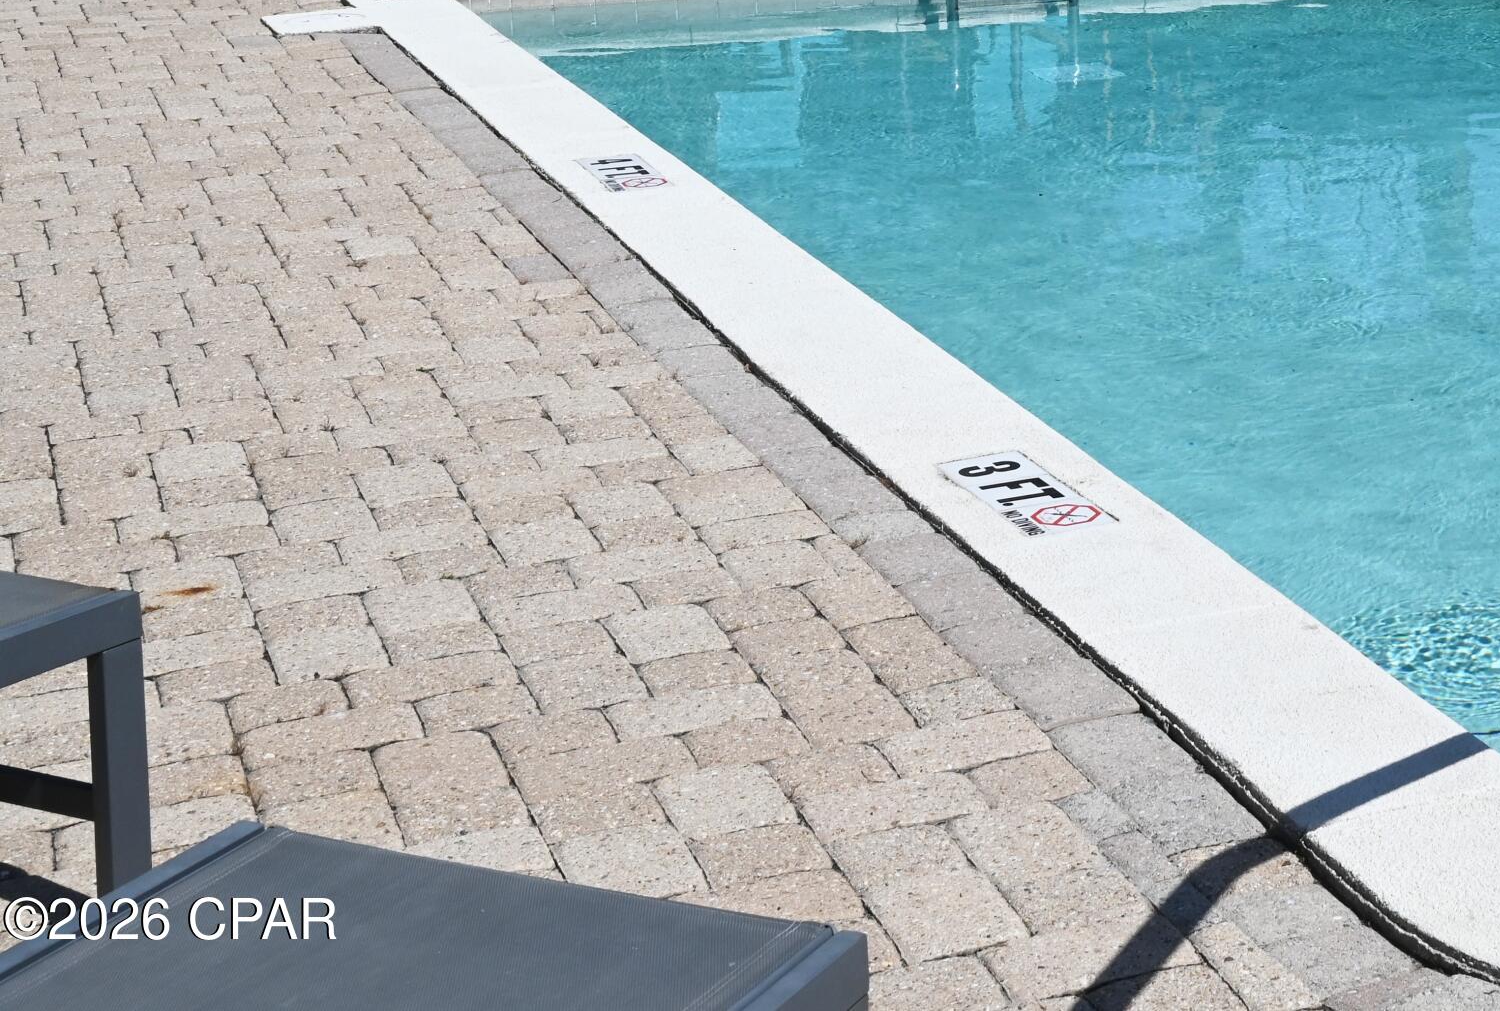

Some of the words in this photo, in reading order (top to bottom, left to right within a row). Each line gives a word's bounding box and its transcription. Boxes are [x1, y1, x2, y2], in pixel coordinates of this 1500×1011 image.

[589, 158, 633, 166] 4
[958, 460, 1021, 477] 3
[978, 477, 1066, 507] FT.
[1000, 509, 1023, 519] NO
[1011, 518, 1045, 536] DIVING
